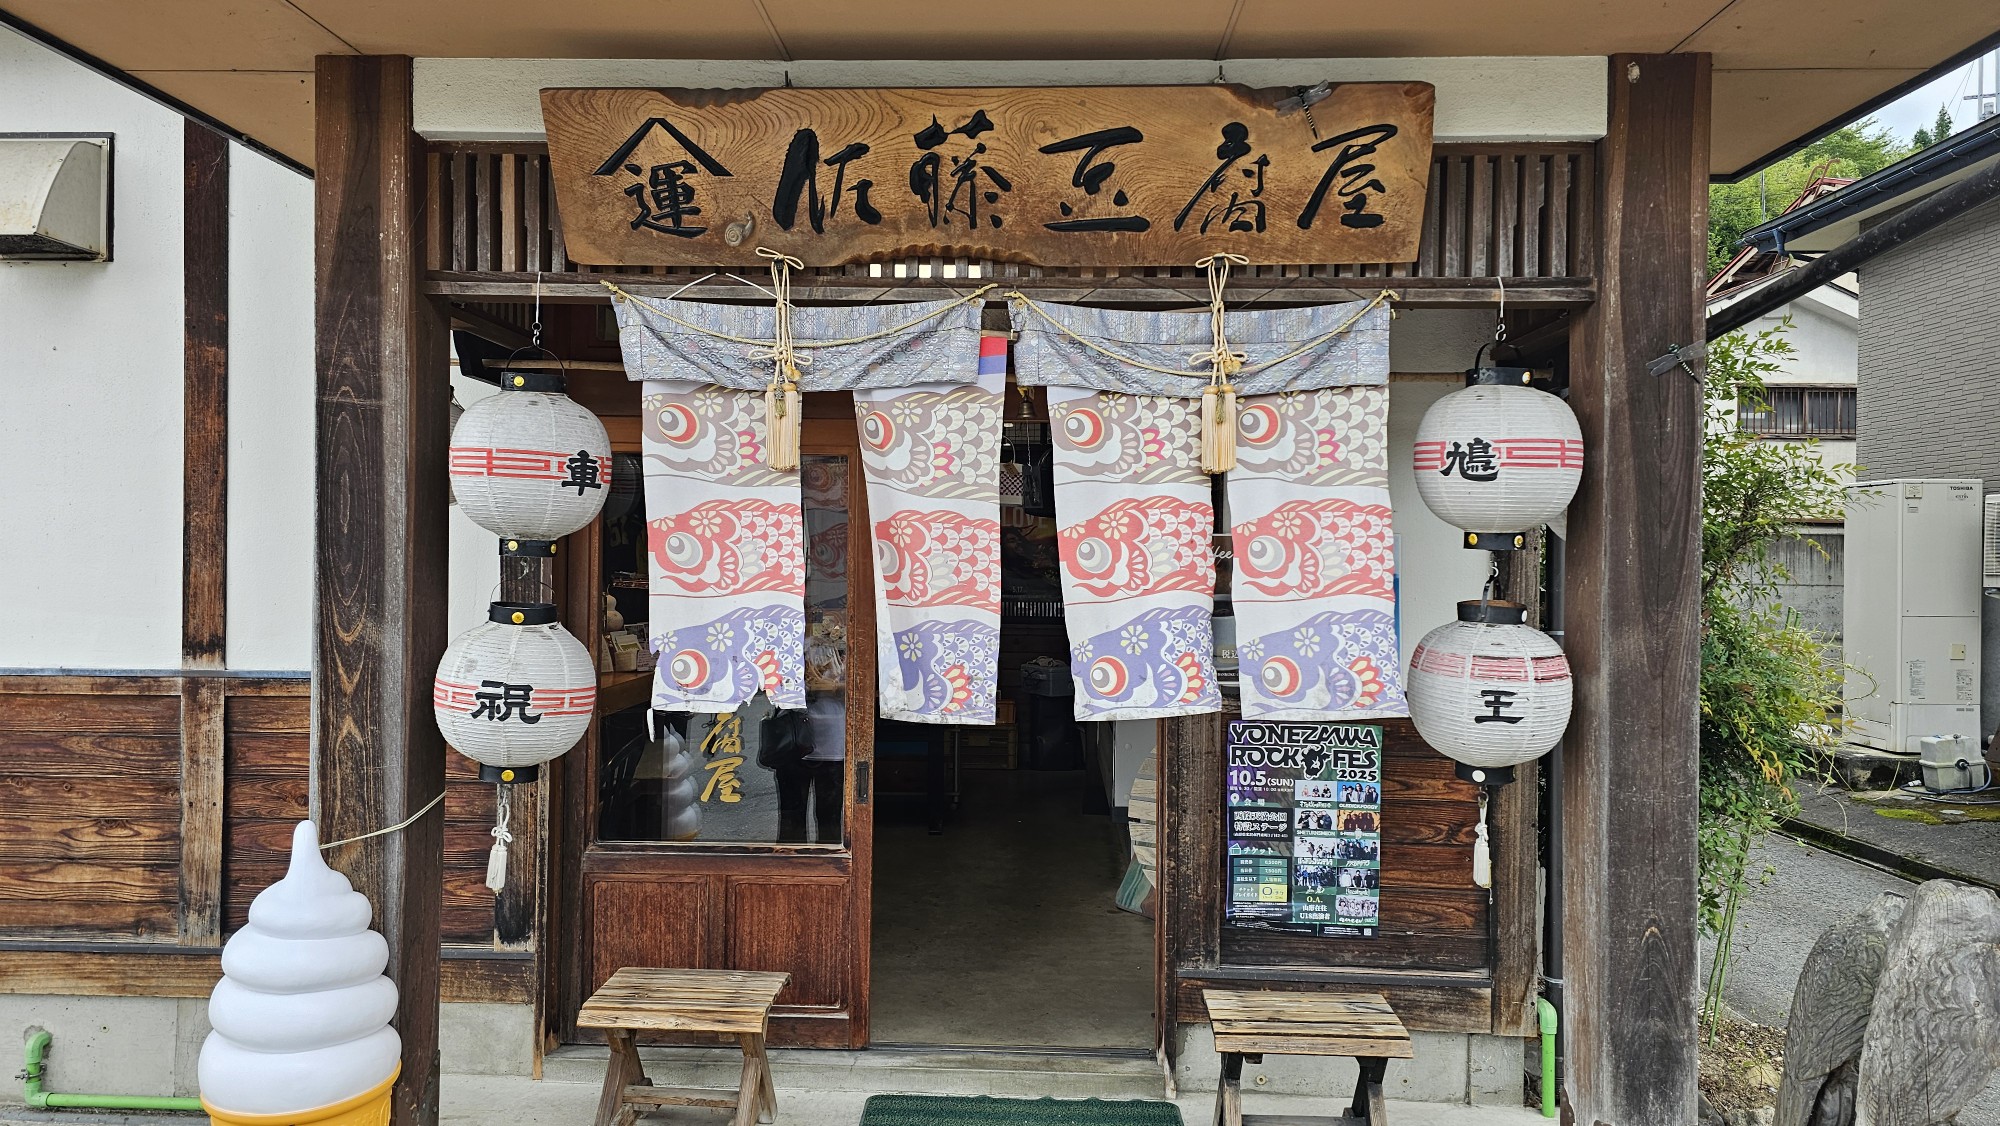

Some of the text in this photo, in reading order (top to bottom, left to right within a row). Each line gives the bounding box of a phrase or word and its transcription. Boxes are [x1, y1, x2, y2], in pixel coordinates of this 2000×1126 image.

[773, 109, 1400, 233] 佐藤豆腐屋
[562, 449, 602, 497] 車
[470, 680, 543, 725] 祝
[1230, 724, 1380, 748] YONEZAWA
[1230, 745, 1379, 769] ROCK FES
[1337, 769, 1378, 781] 2025
